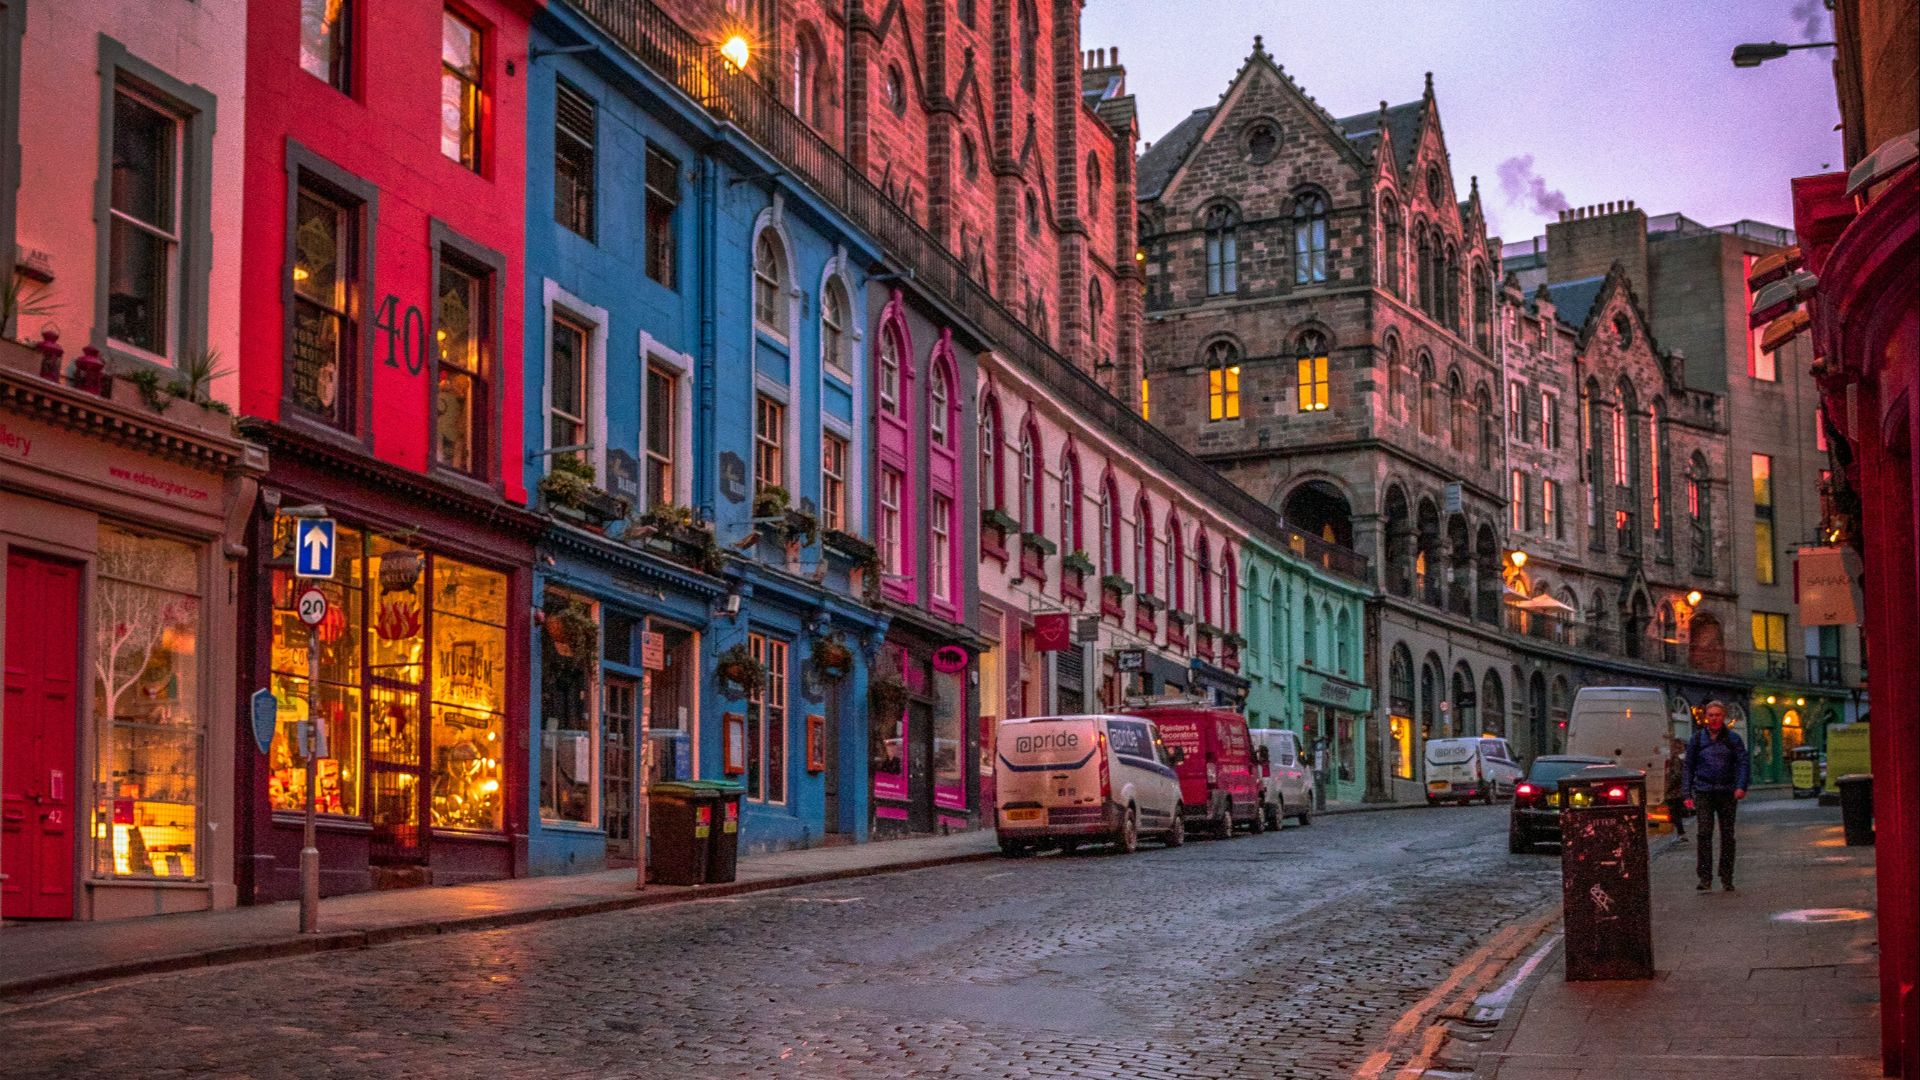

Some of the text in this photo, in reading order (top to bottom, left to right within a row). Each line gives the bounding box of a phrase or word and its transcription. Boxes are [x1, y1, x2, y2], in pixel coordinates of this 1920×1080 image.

[375, 293, 425, 376] 40
[302, 600, 324, 617] 20
[440, 650, 493, 688] MUSEUM
[48, 809, 63, 824] 42
